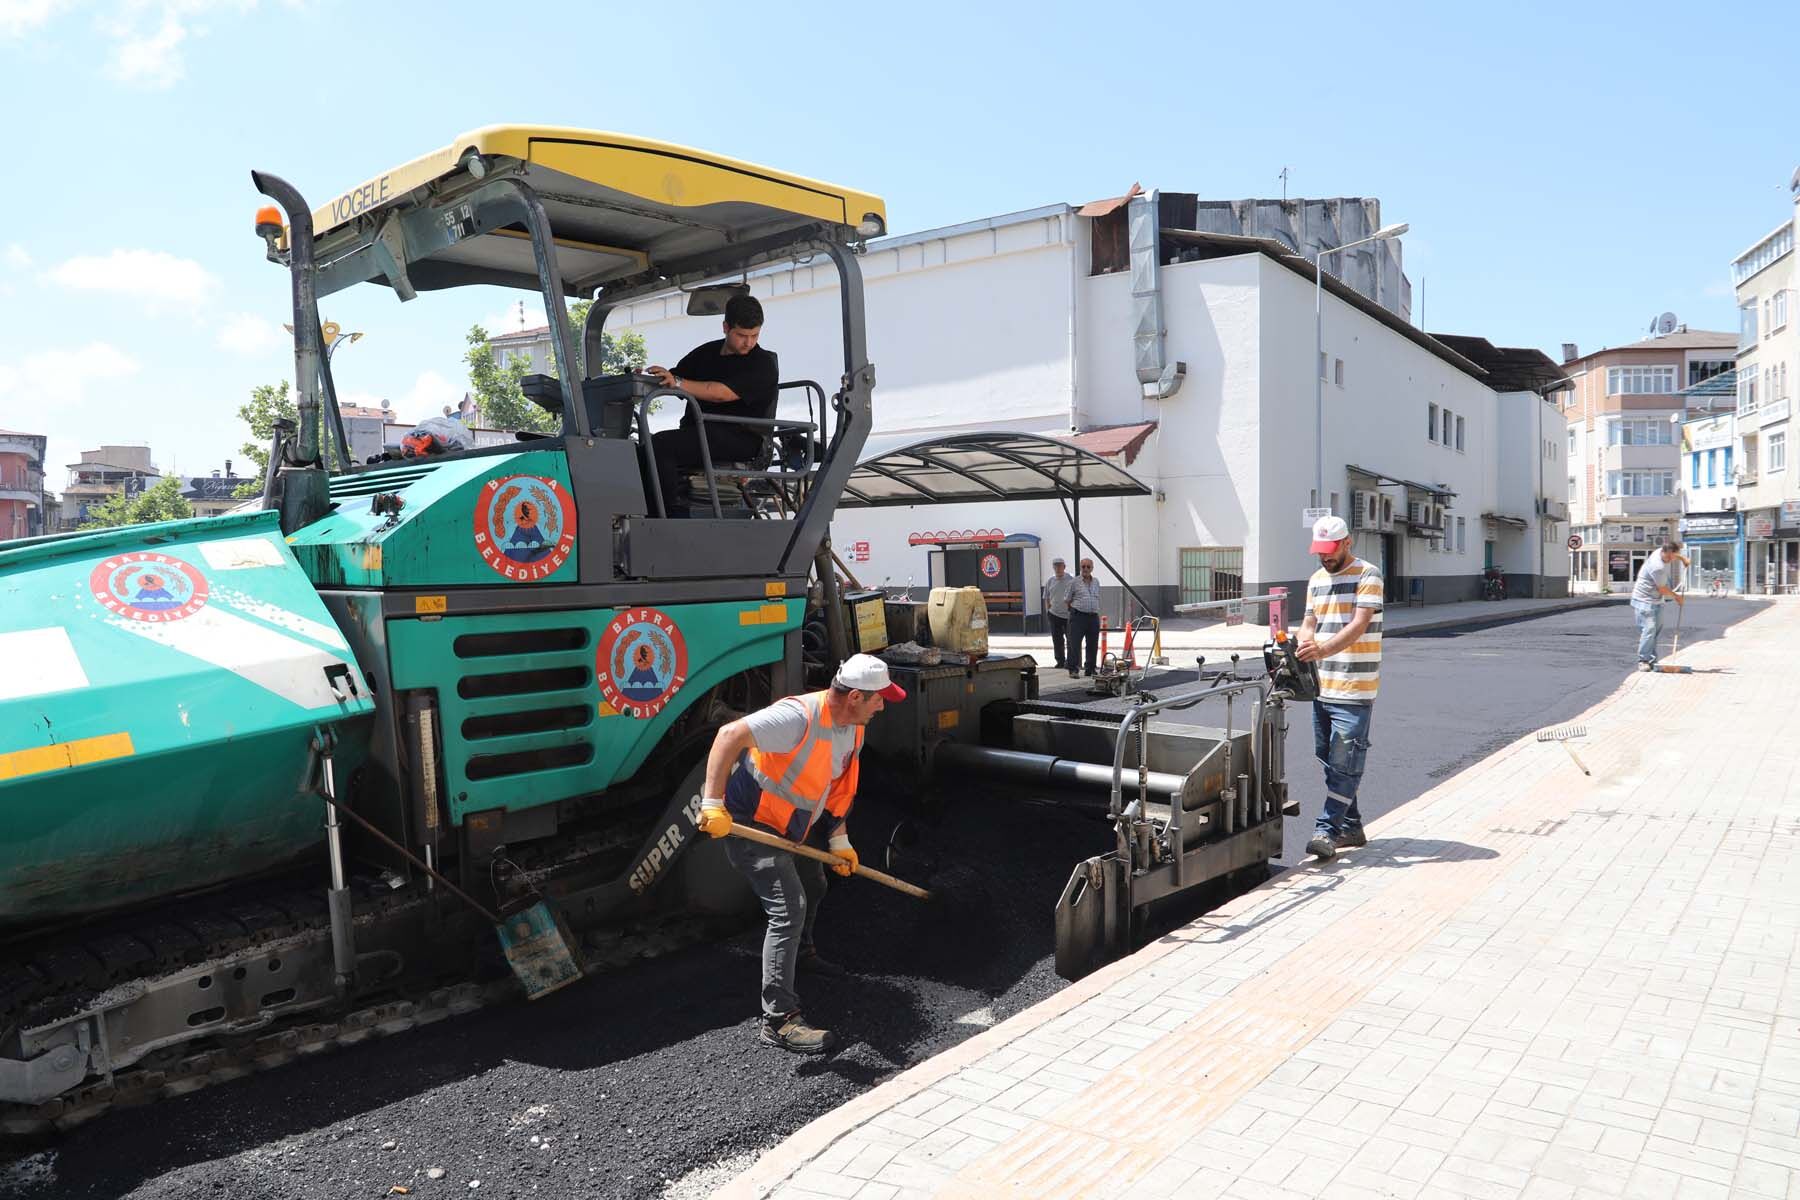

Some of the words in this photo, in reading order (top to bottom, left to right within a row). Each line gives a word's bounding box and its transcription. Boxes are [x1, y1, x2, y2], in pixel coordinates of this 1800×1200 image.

[444, 211, 455, 226] 55
[460, 205, 470, 219] 12
[452, 222, 465, 239] 711
[105, 554, 183, 569] BAFRA
[612, 610, 674, 635] BAFRA
[629, 824, 685, 896] SUPER
[682, 784, 706, 826] 18
